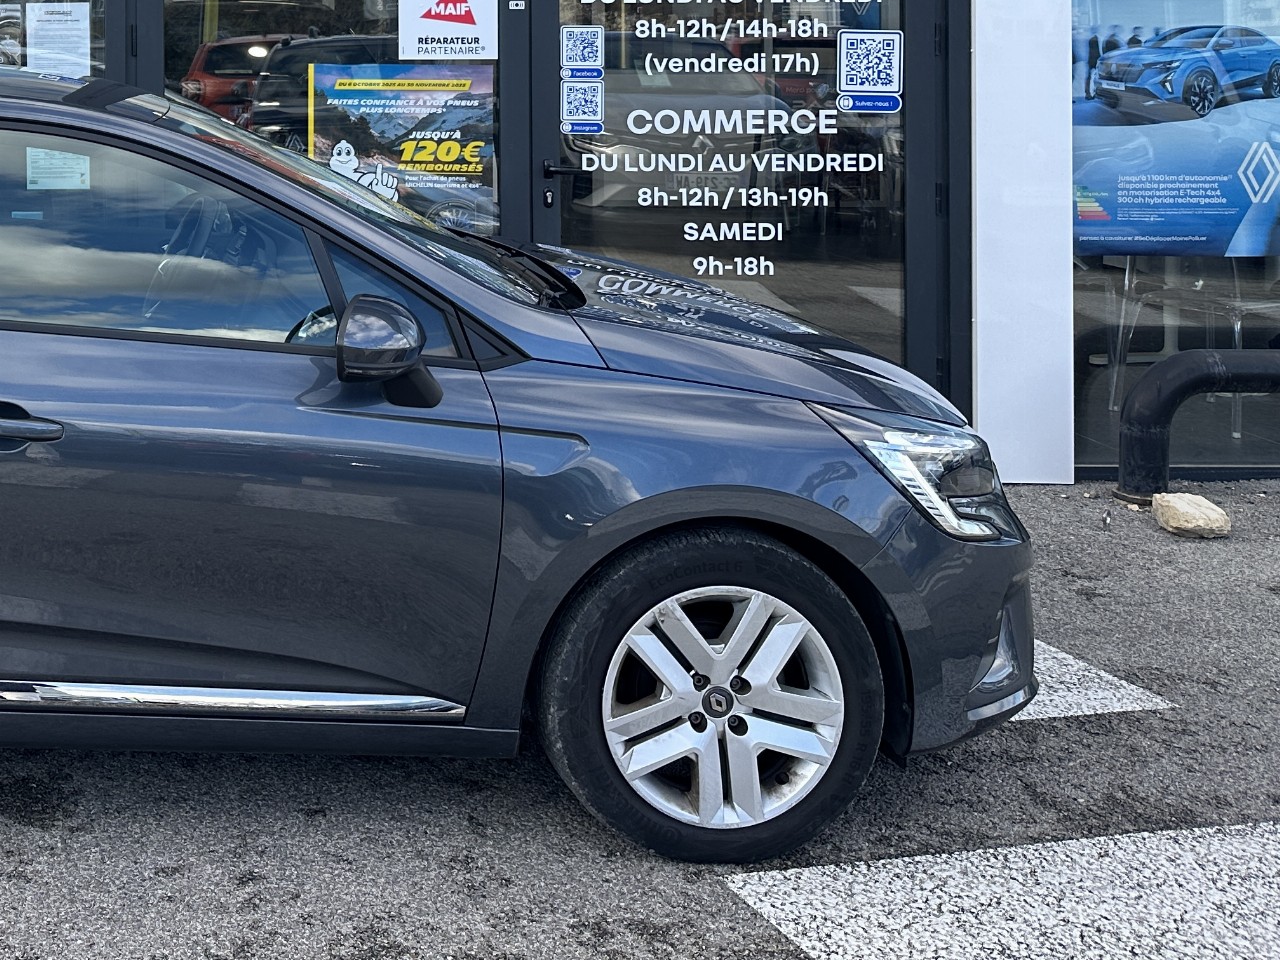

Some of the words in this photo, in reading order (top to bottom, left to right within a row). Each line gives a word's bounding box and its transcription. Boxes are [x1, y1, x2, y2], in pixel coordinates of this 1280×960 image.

[431, 3, 470, 16] MAIF
[418, 35, 480, 45] RÉPARATEUR
[644, 52, 766, 76] (vendredi
[771, 52, 819, 76] 17h)
[360, 98, 416, 106] CONFIANCE
[446, 99, 480, 107] PNEUS
[626, 109, 838, 135] COMMERCE
[408, 130, 461, 141] JUSQU'À
[399, 140, 486, 162] 120€
[397, 162, 483, 172] REMBOURSÉS
[581, 154, 619, 172] DU
[624, 154, 703, 172] LUNDI
[708, 154, 746, 172] AU
[751, 153, 883, 172] VENDREDI
[1118, 174, 1147, 183] jusqu'à
[1117, 181, 1159, 190] disponible
[1159, 181, 1219, 190] prochainement
[1145, 197, 1174, 205] hybride
[1175, 197, 1227, 205] rechargeable
[683, 222, 783, 241] SAMEDI
[693, 256, 774, 276] 9h-18h
[649, 559, 730, 590] EcoContact
